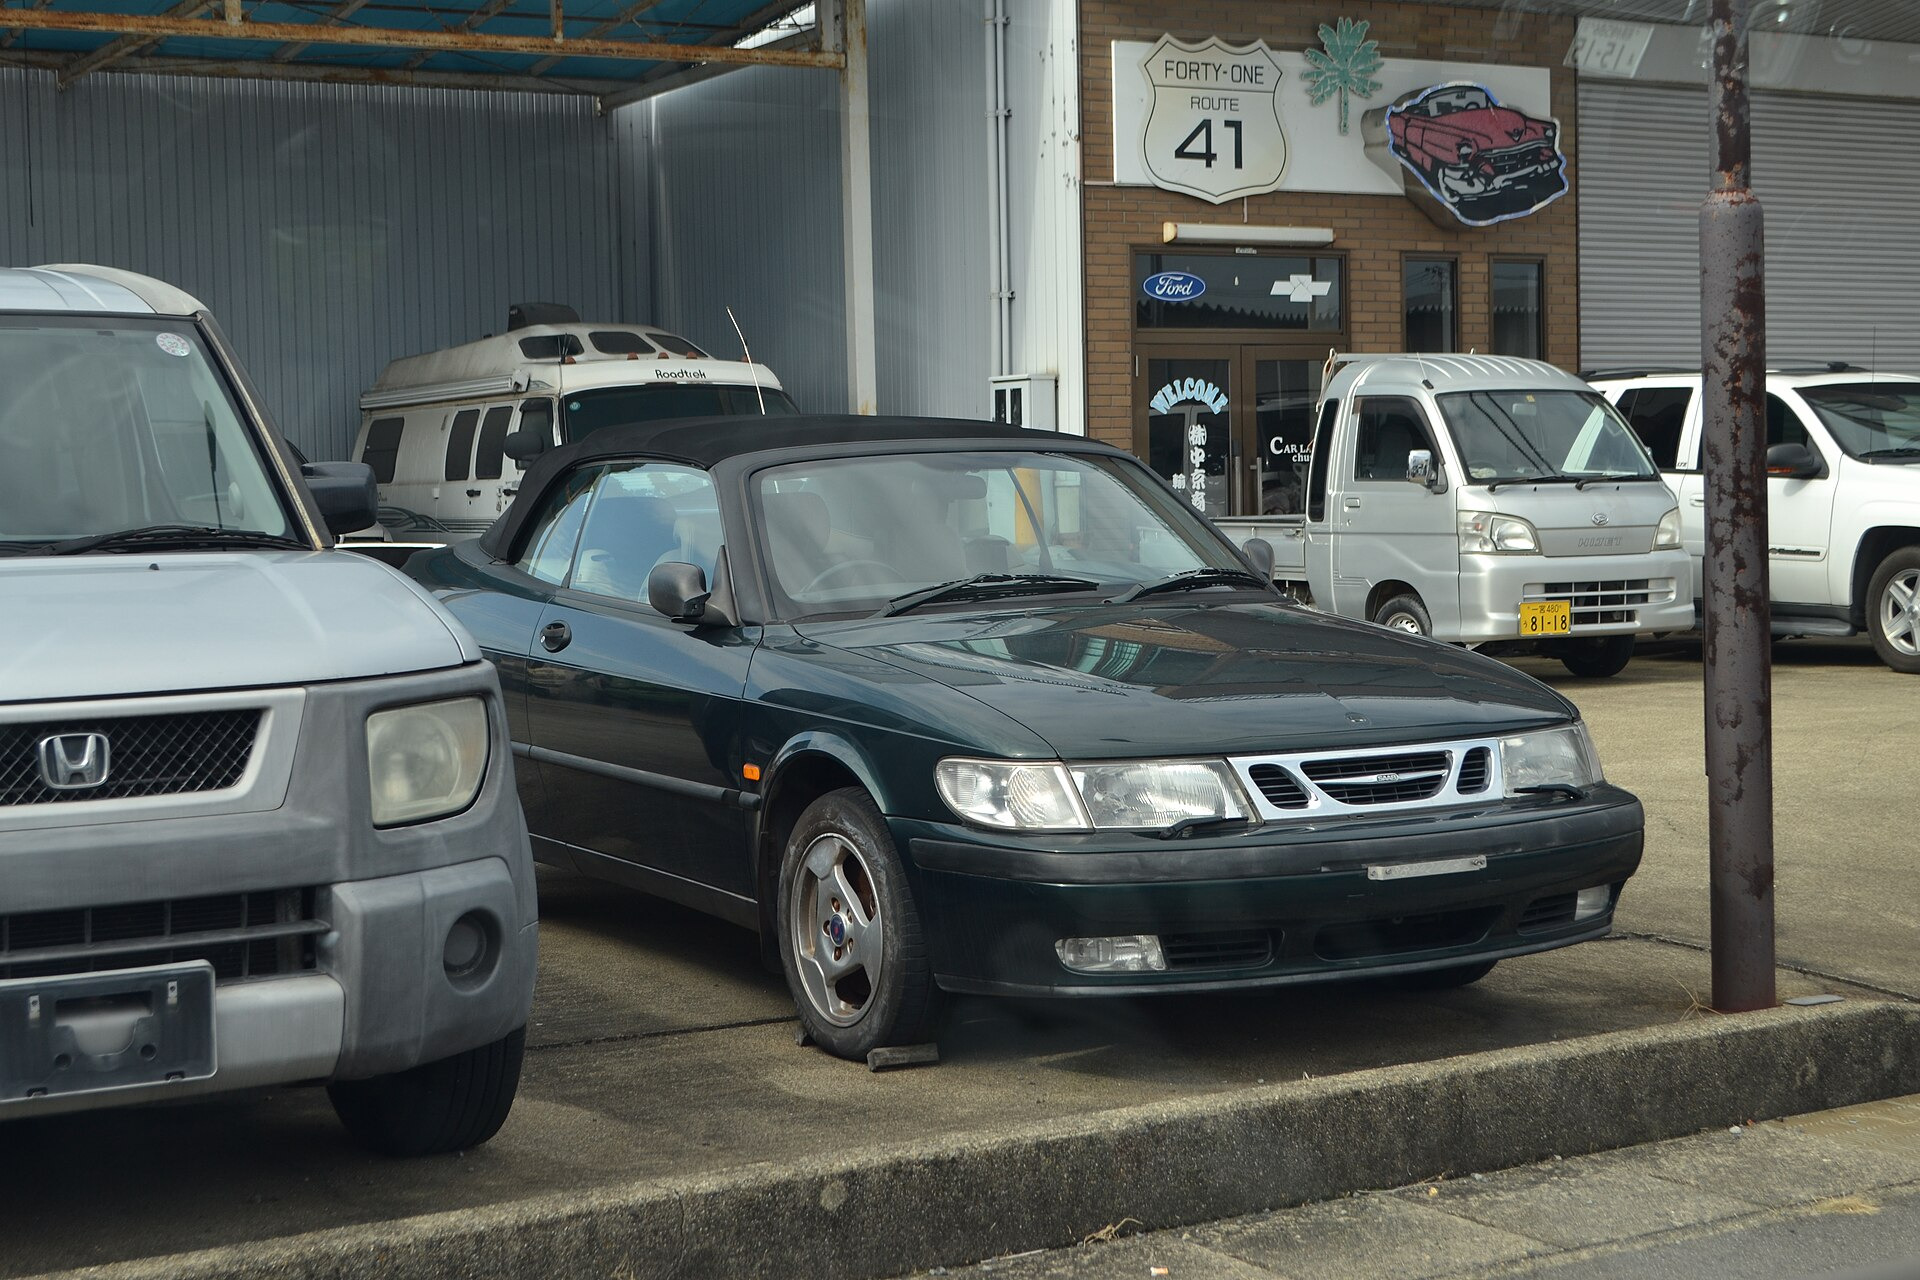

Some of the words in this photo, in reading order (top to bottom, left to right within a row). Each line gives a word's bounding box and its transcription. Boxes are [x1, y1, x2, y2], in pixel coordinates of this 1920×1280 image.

[1164, 60, 1264, 85] FORTY-ONE
[1190, 96, 1239, 112] ROUTE
[1174, 118, 1243, 170] 41
[1155, 275, 1194, 296] Ford
[654, 369, 706, 379] Roadtrek
[1150, 377, 1229, 415] WELCOME
[1270, 436, 1298, 455] CAR
[1530, 614, 1567, 632] 81-18
